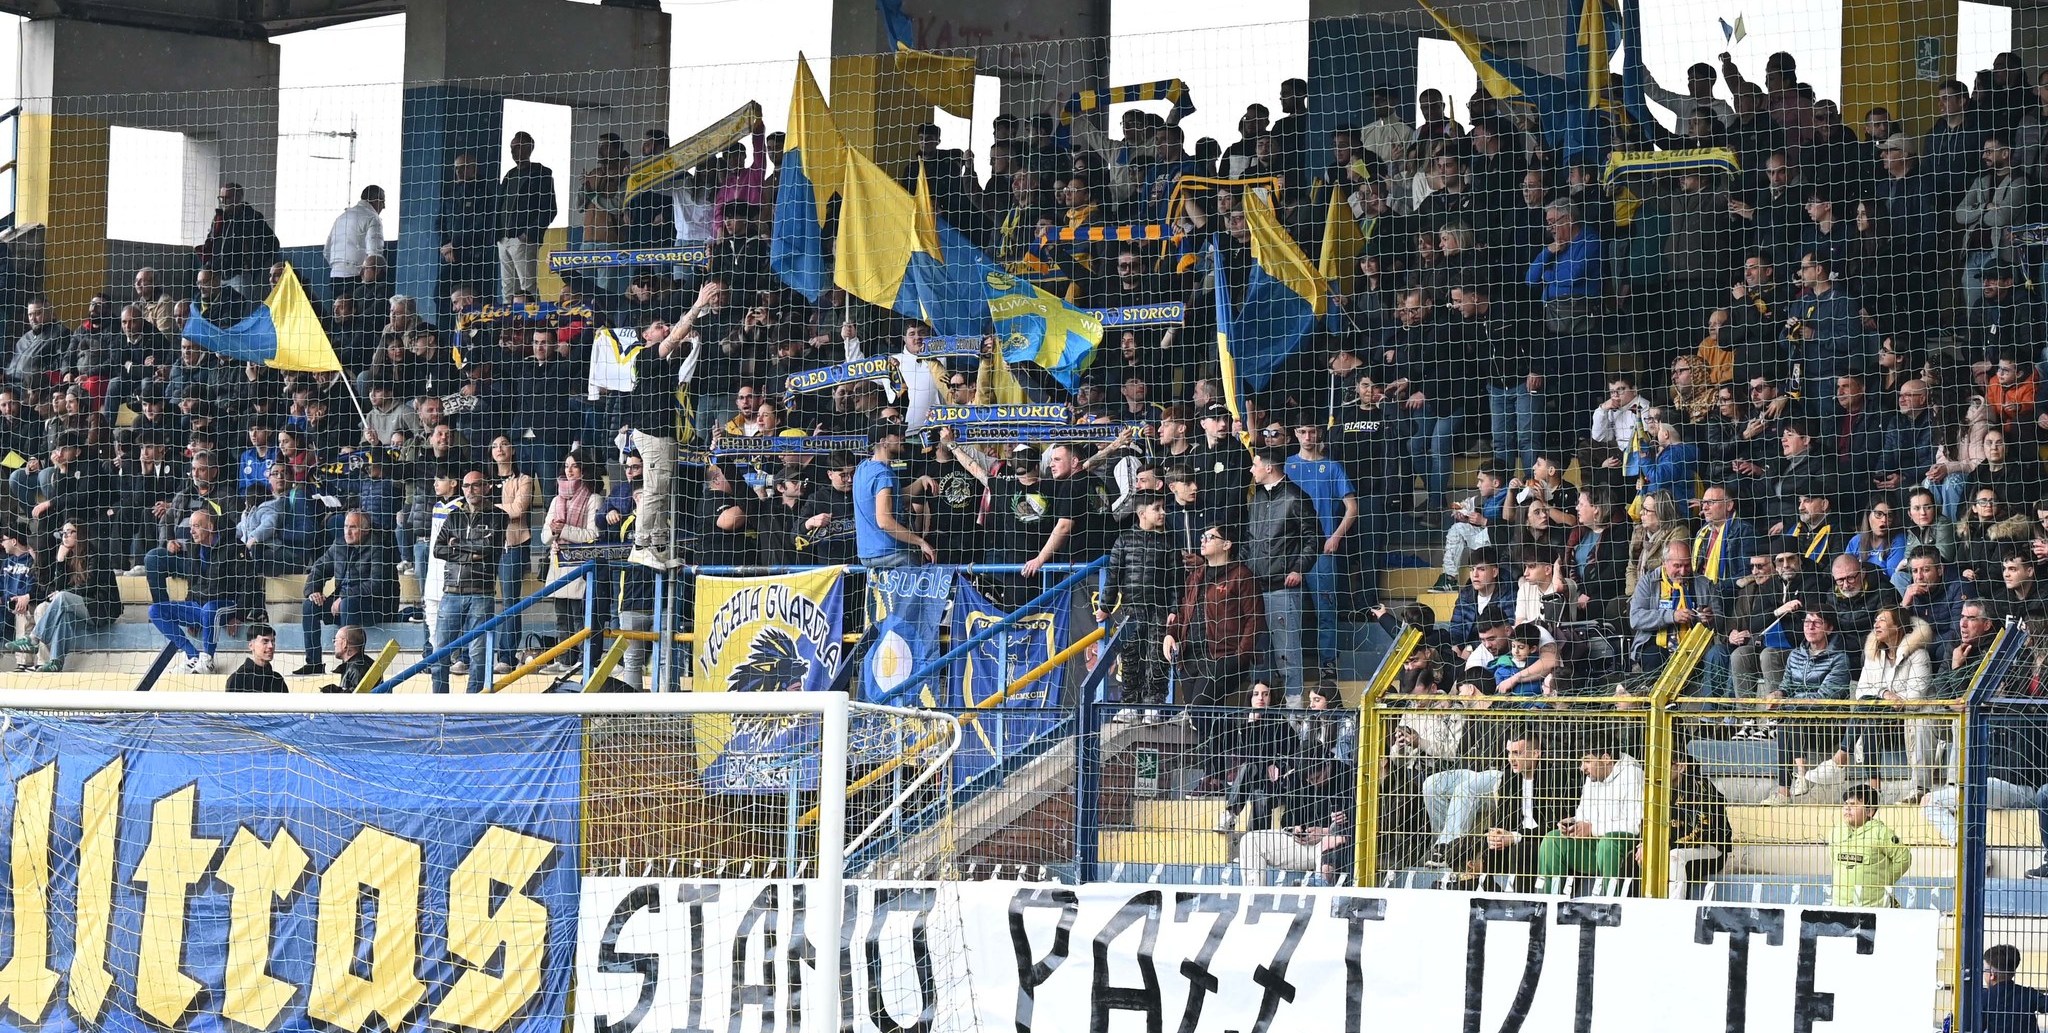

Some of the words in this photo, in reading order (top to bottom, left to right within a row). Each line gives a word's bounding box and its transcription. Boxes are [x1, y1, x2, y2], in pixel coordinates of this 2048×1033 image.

[552, 255, 612, 267] NUCLEO
[635, 251, 704, 262] STORICO
[990, 298, 1048, 313] ALWAS
[1123, 305, 1180, 321] STORICO
[1344, 421, 1380, 431] GIARRE
[765, 584, 841, 678] GUARDIA
[593, 882, 937, 1033] SIAMO
[1008, 888, 1387, 1033] PAZZI
[1463, 898, 1622, 1033] DI
[1693, 906, 1877, 1033] TE
